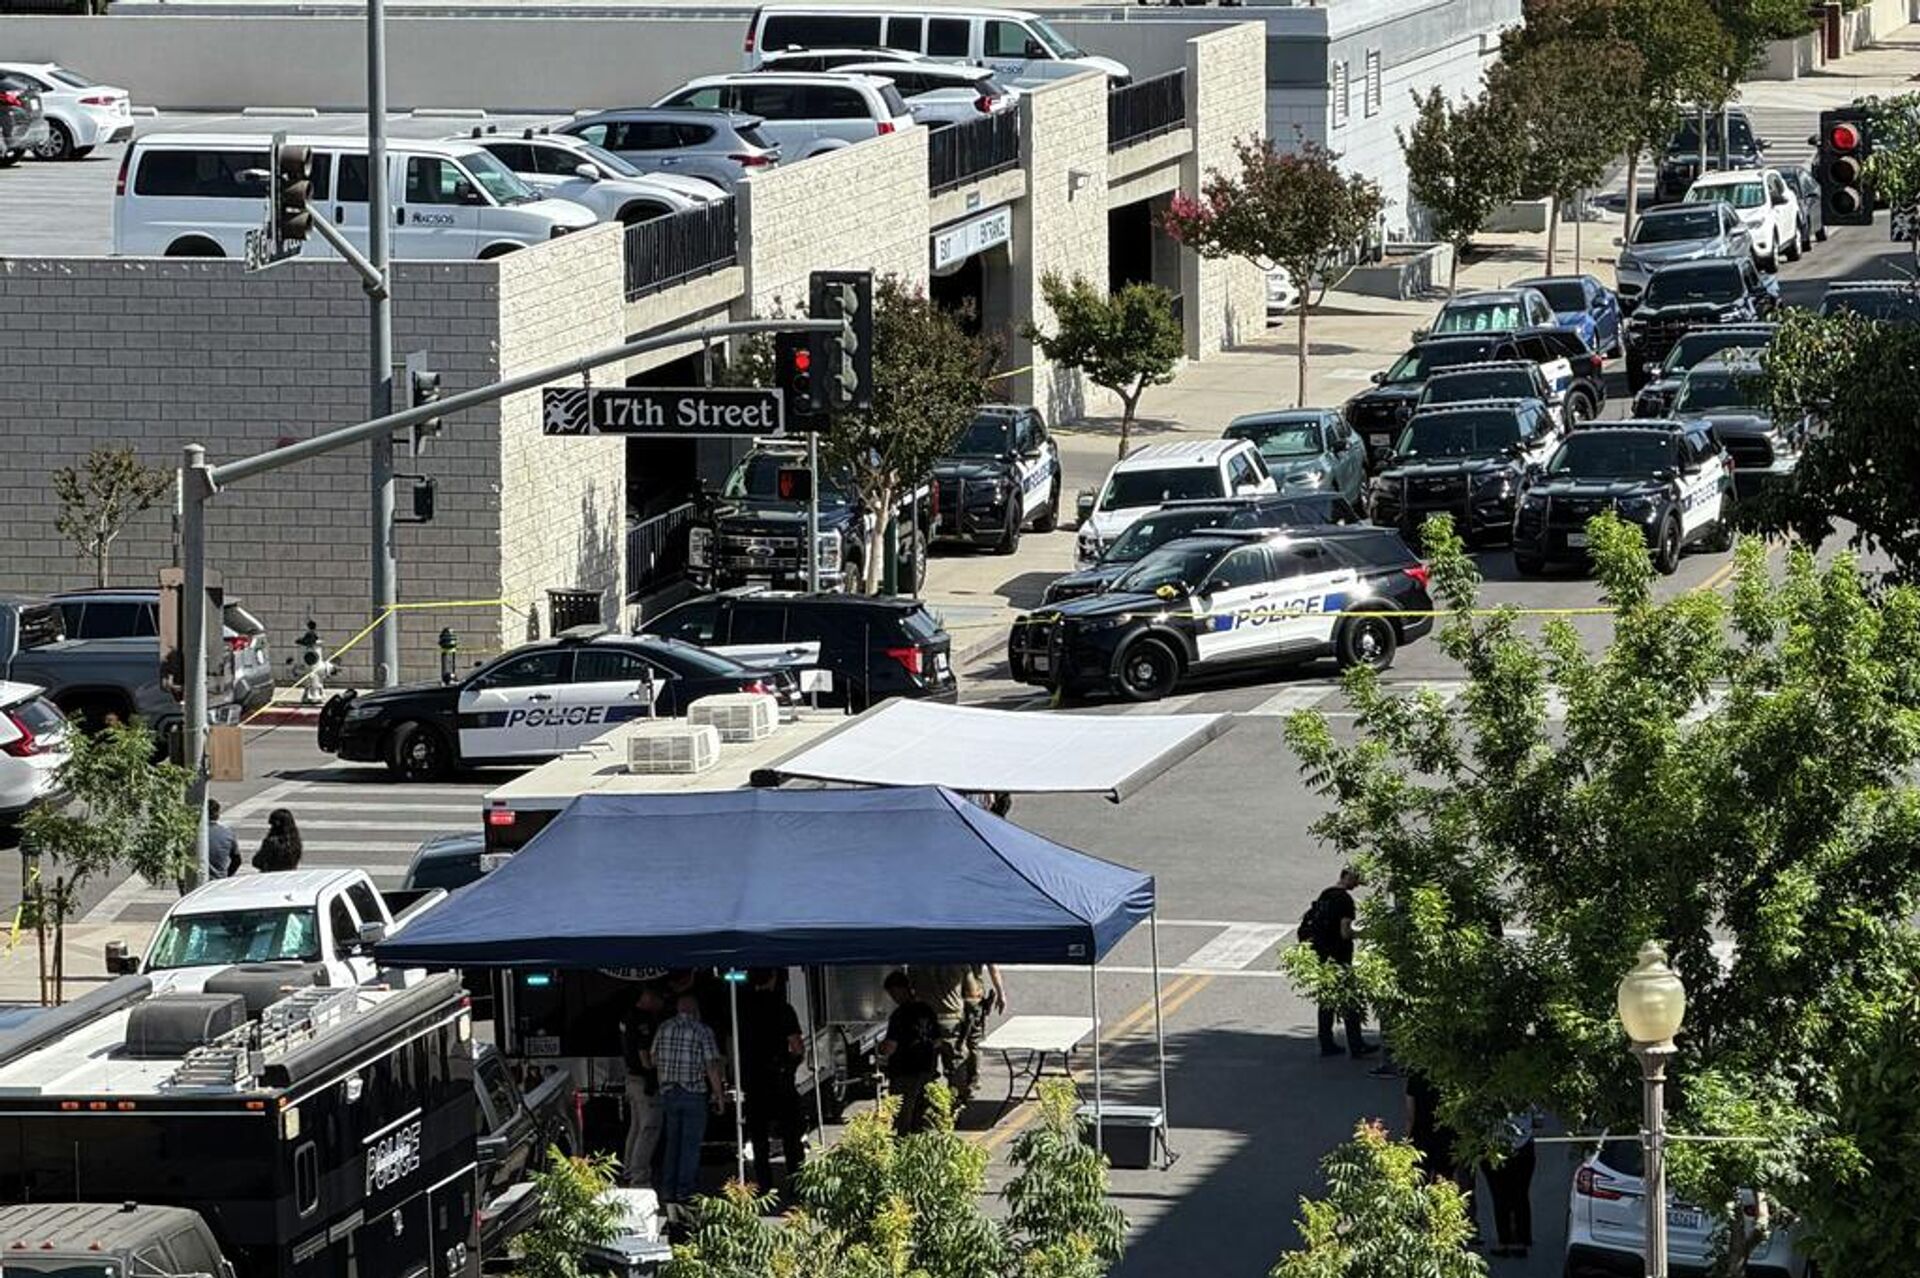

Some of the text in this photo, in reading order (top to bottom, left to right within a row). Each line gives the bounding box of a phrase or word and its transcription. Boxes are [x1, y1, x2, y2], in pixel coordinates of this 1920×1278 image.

[603, 398, 773, 427] 17th Street
[1235, 595, 1322, 630] POLICE
[508, 705, 604, 727] POLICE
[366, 1120, 422, 1197] POLICE
